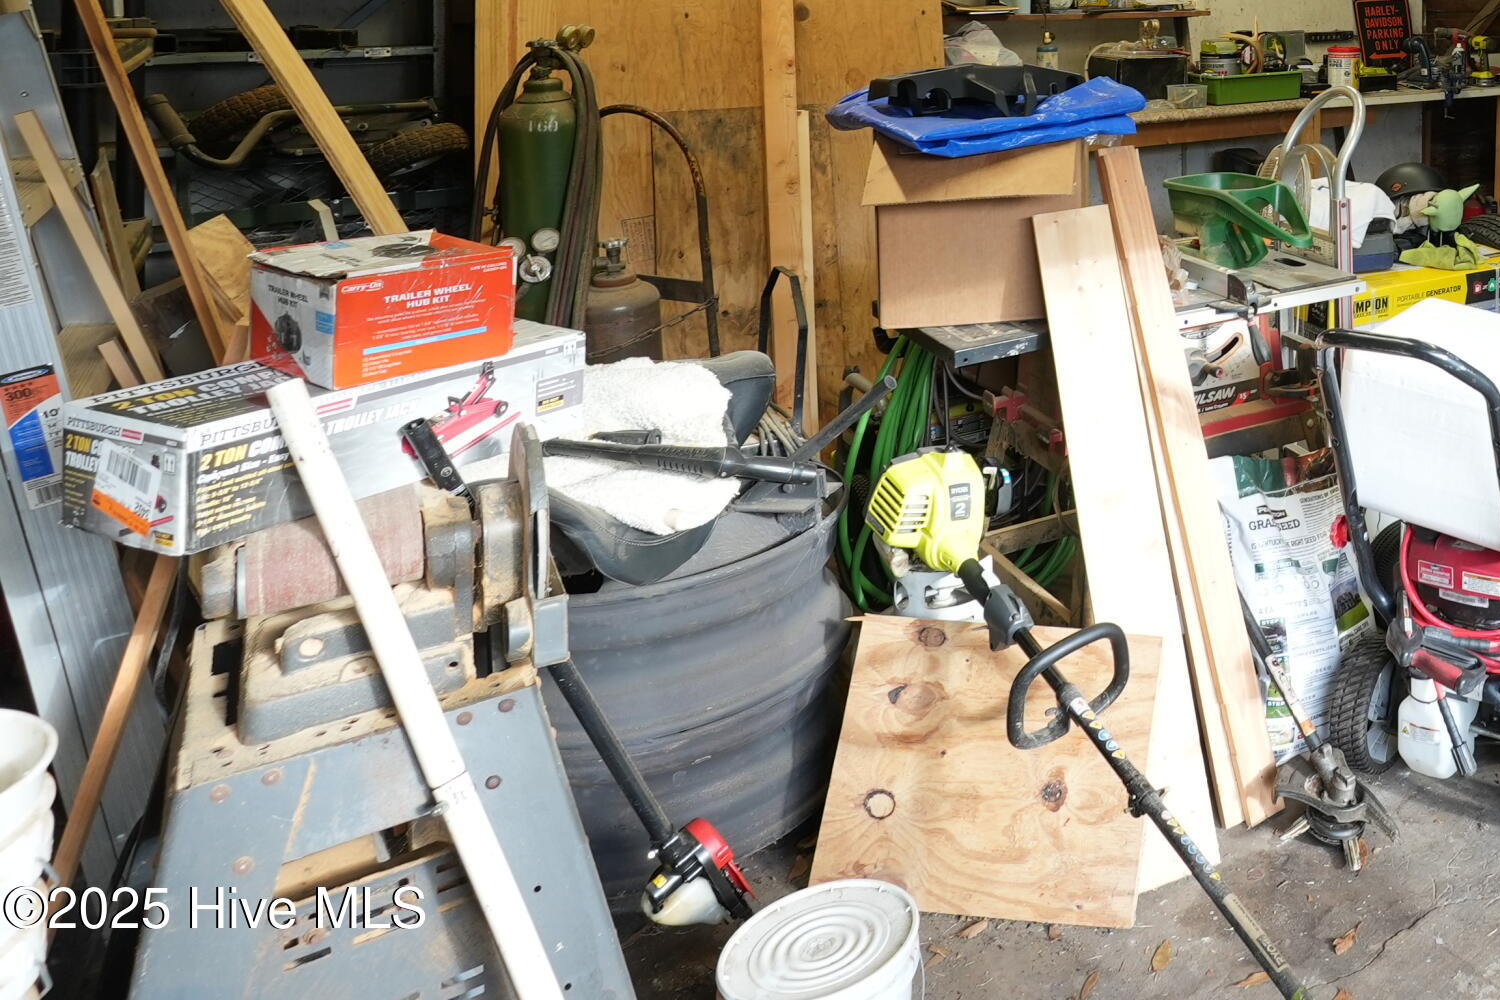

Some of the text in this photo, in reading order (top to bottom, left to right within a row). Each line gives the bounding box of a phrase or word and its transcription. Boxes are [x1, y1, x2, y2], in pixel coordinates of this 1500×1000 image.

[1364, 4, 1399, 16] HARLEY-
[1364, 16, 1403, 28] DAVIDSON
[1366, 28, 1404, 39] PARKING
[1375, 40, 1399, 51] ONLY
[384, 283, 472, 304] TRAILER WHEEL
[1426, 284, 1462, 297] GENERATOR
[406, 294, 451, 309] HUB KIT
[111, 370, 286, 411] 2 TON COMP
[131, 386, 243, 414] TROLLEY
[1194, 386, 1236, 405] ILSAW
[66, 416, 122, 437] PITTSBURGH
[326, 407, 385, 436] TROLLEY
[200, 416, 281, 447] PITTSBU
[73, 435, 93, 453] TON
[199, 453, 213, 473] 2
[213, 443, 248, 468] TON
